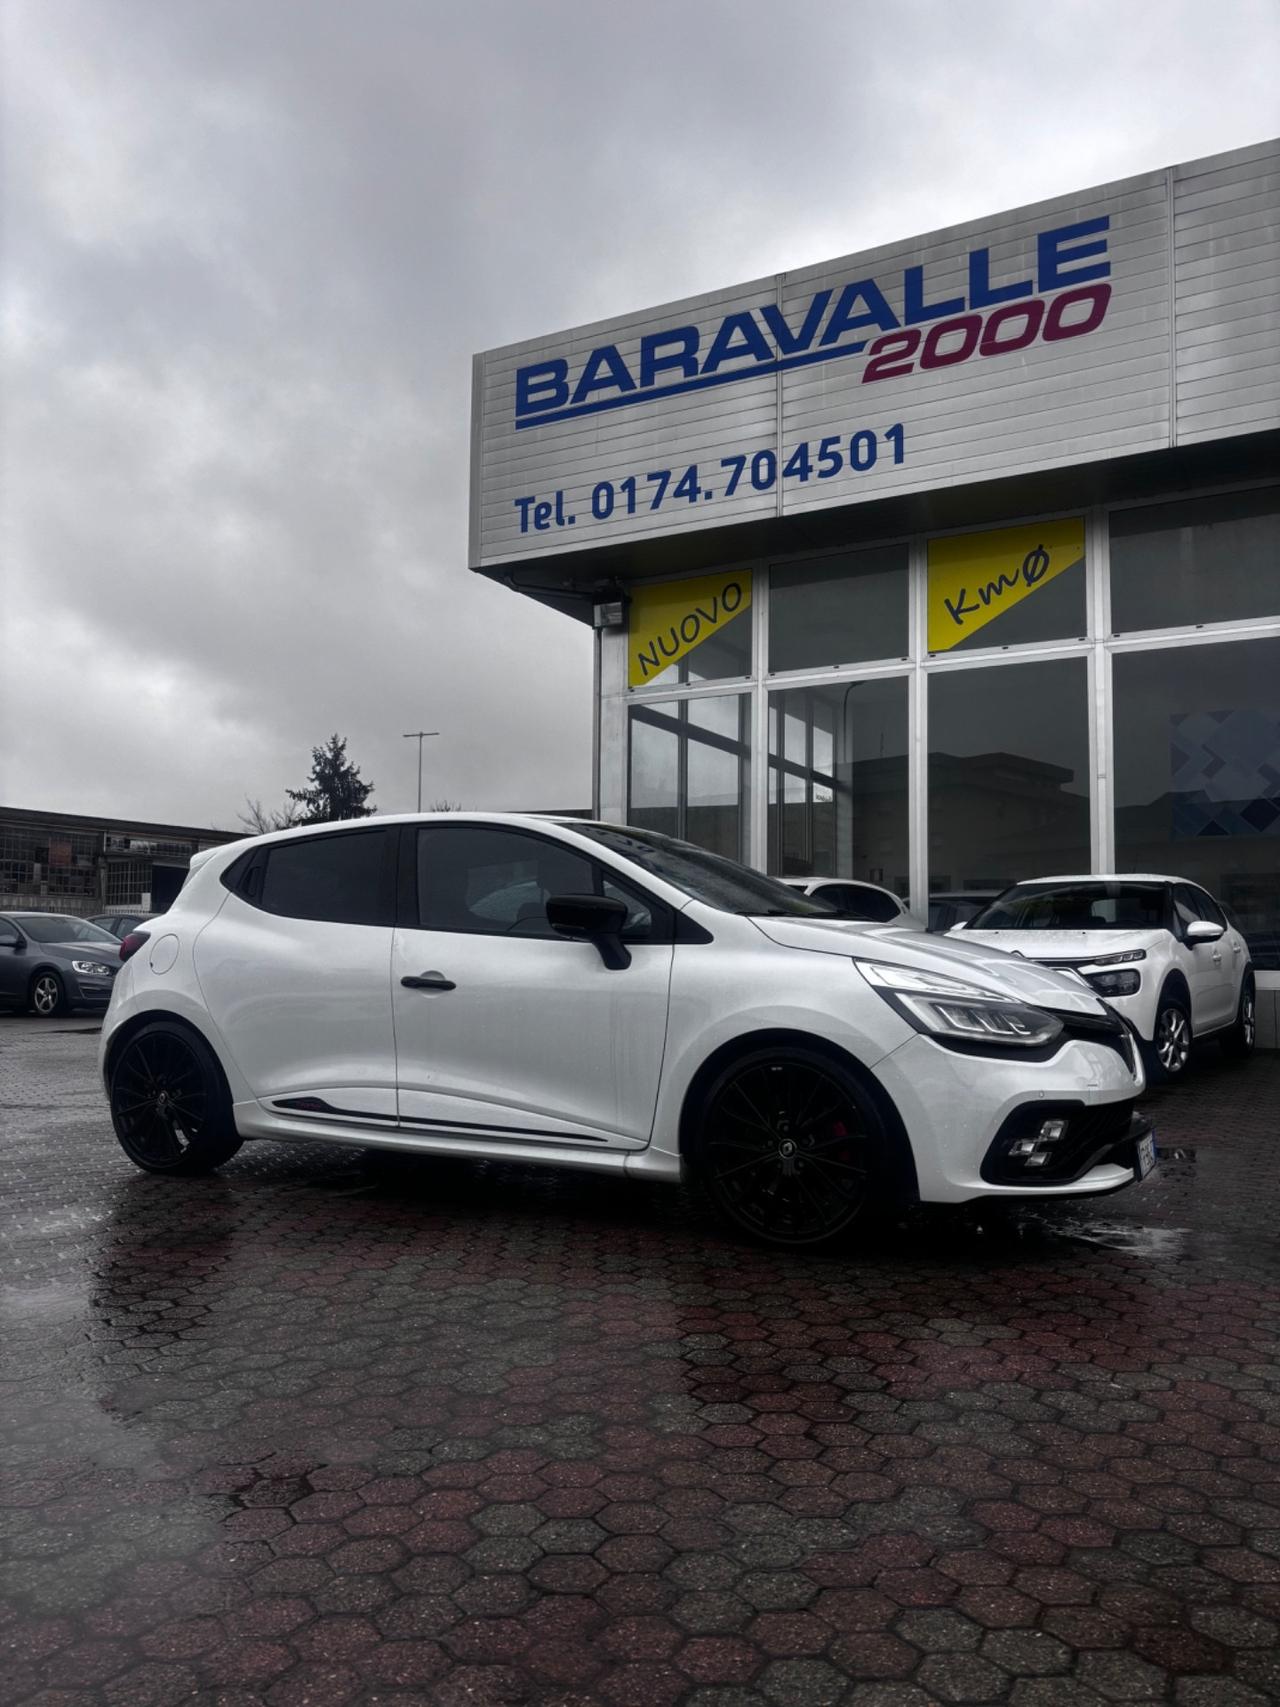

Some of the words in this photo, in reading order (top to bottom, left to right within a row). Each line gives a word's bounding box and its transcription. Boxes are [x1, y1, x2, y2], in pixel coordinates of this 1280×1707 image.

[515, 216, 1110, 418] BARAVALLE
[861, 283, 1112, 383] 2000
[514, 490, 577, 533] Tel.
[591, 422, 904, 520] 0174.704501
[638, 582, 742, 676] NUOVO
